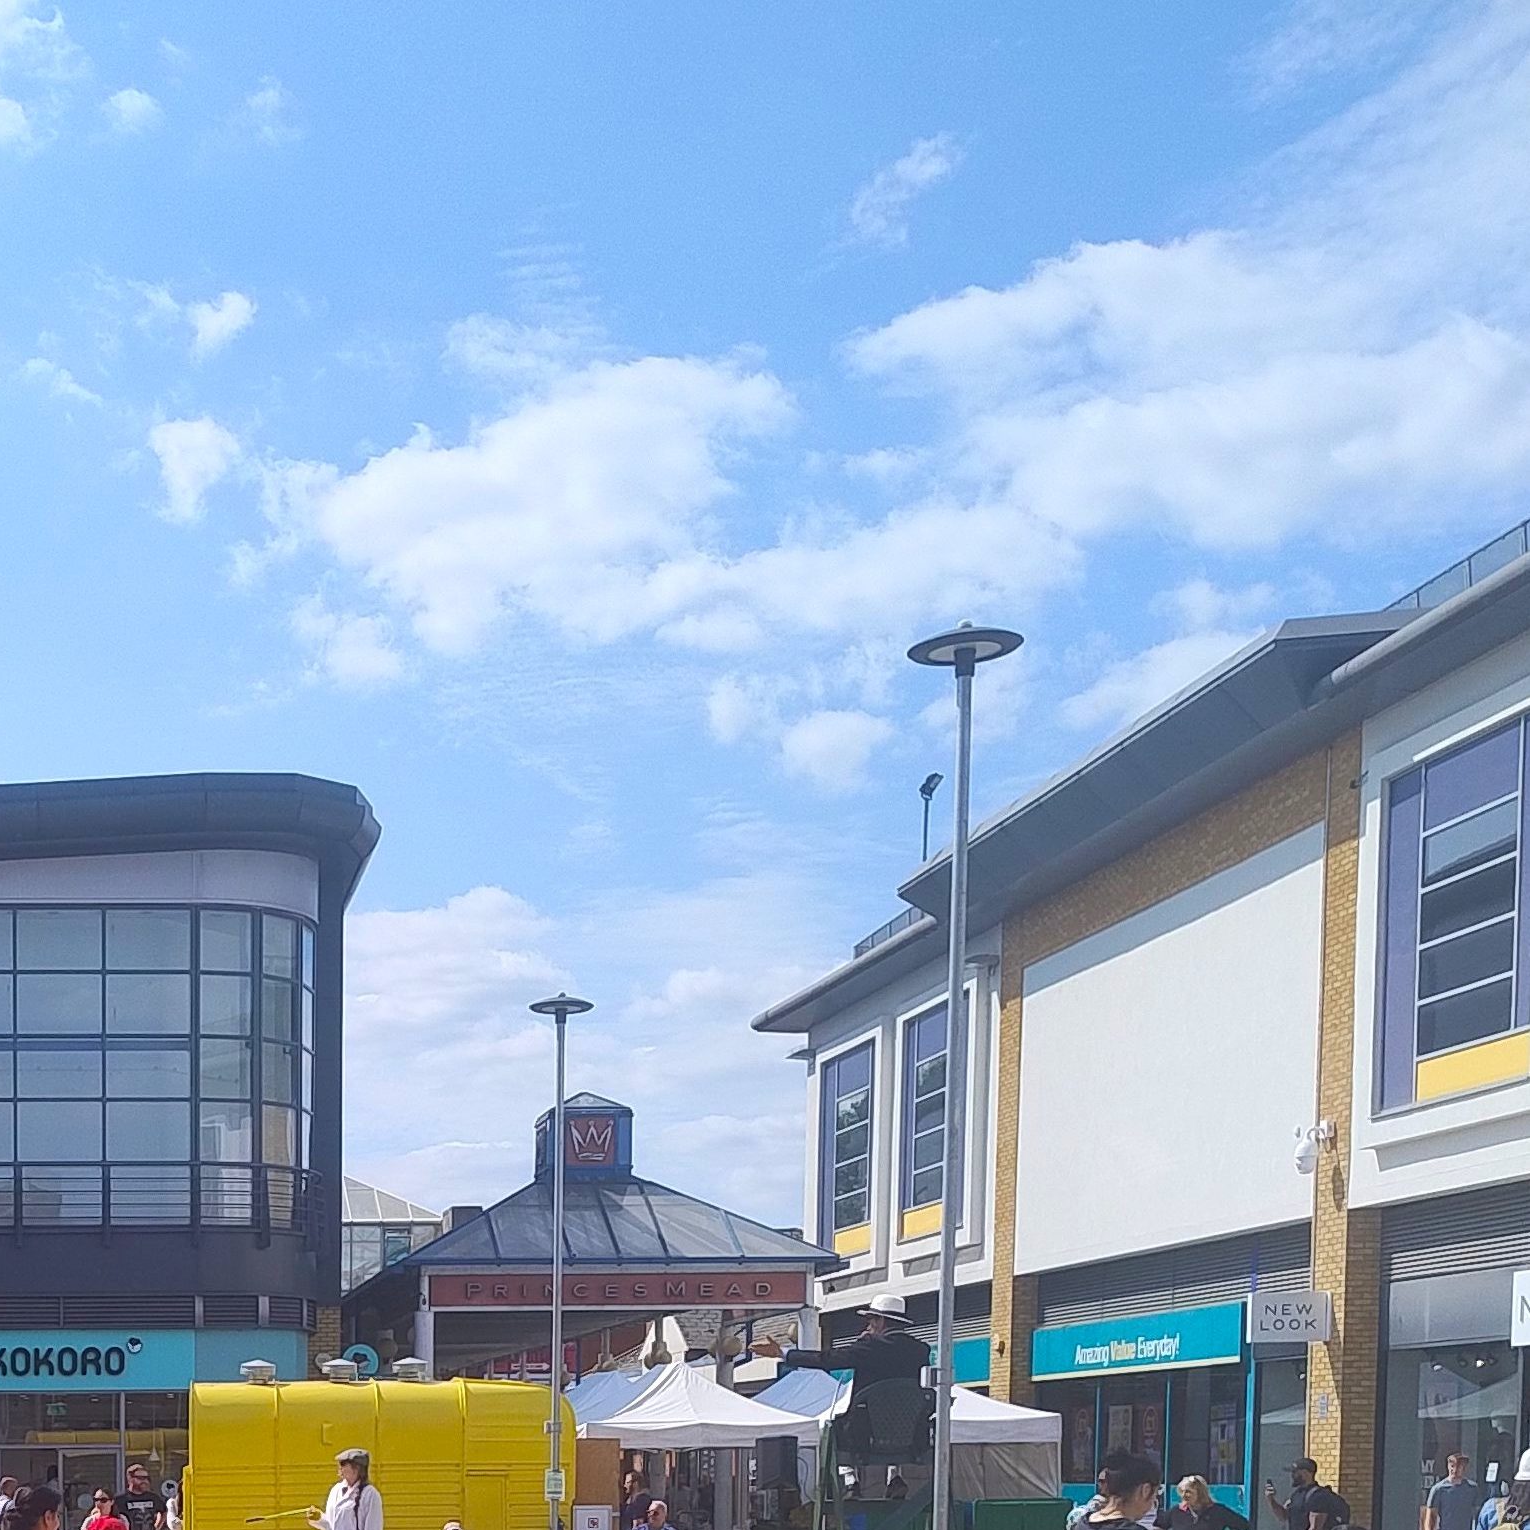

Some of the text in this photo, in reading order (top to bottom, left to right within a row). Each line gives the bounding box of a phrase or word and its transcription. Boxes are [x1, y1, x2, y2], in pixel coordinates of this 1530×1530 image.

[466, 1281, 774, 1300] PRINCES MEAD
[1264, 1303, 1313, 1316] NEW
[1259, 1318, 1317, 1332] LOOK
[1074, 1332, 1181, 1367] Amazing Value Everyday!
